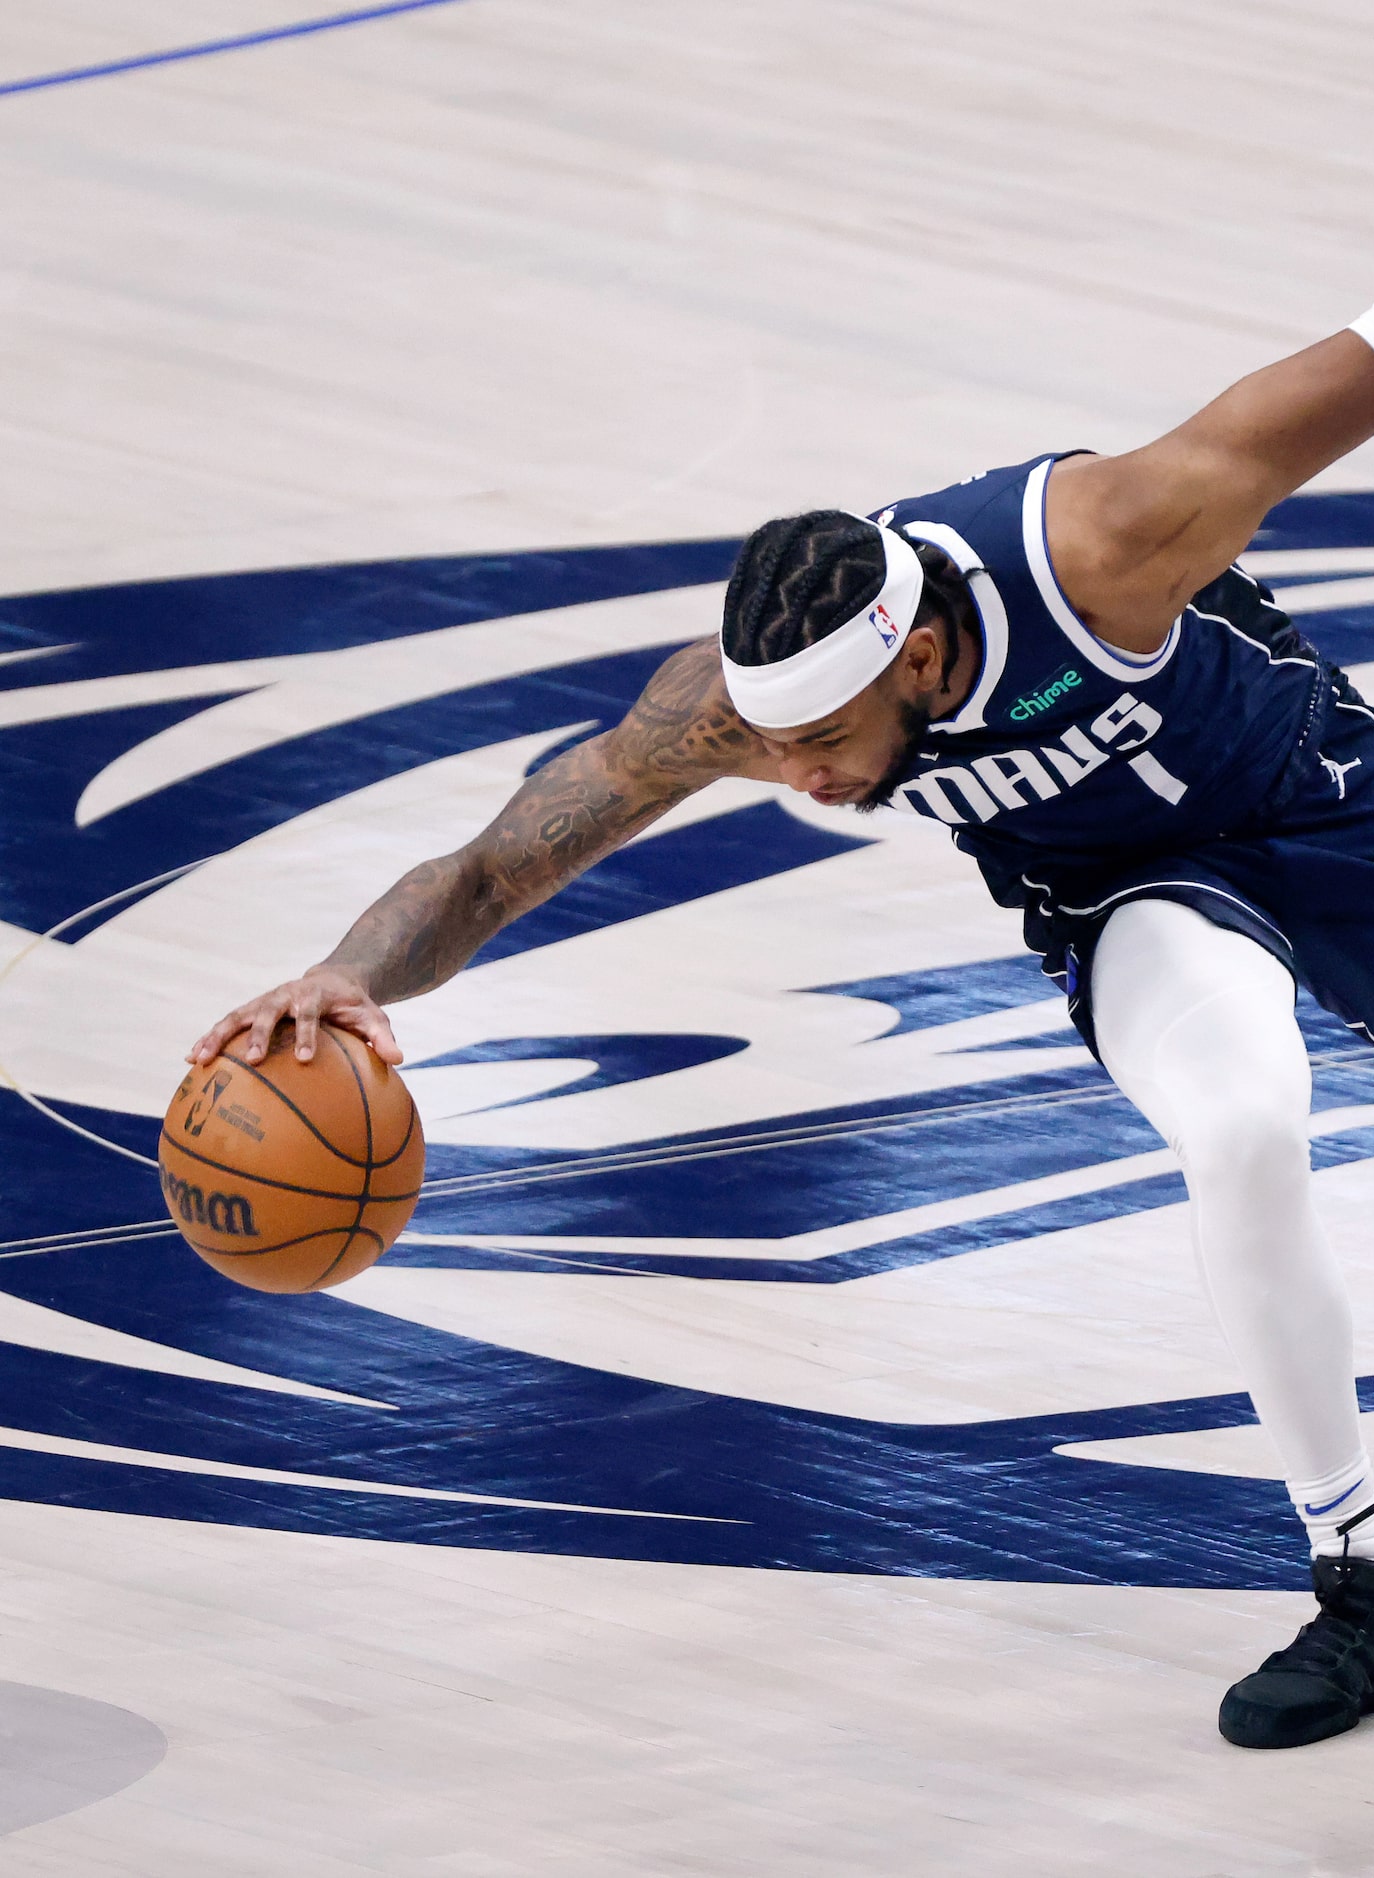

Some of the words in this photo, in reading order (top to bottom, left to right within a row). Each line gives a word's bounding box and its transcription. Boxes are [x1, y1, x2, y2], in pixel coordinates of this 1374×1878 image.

[1010, 668, 1083, 721] chime
[887, 692, 1163, 823] MAVS
[1127, 750, 1188, 806] 1
